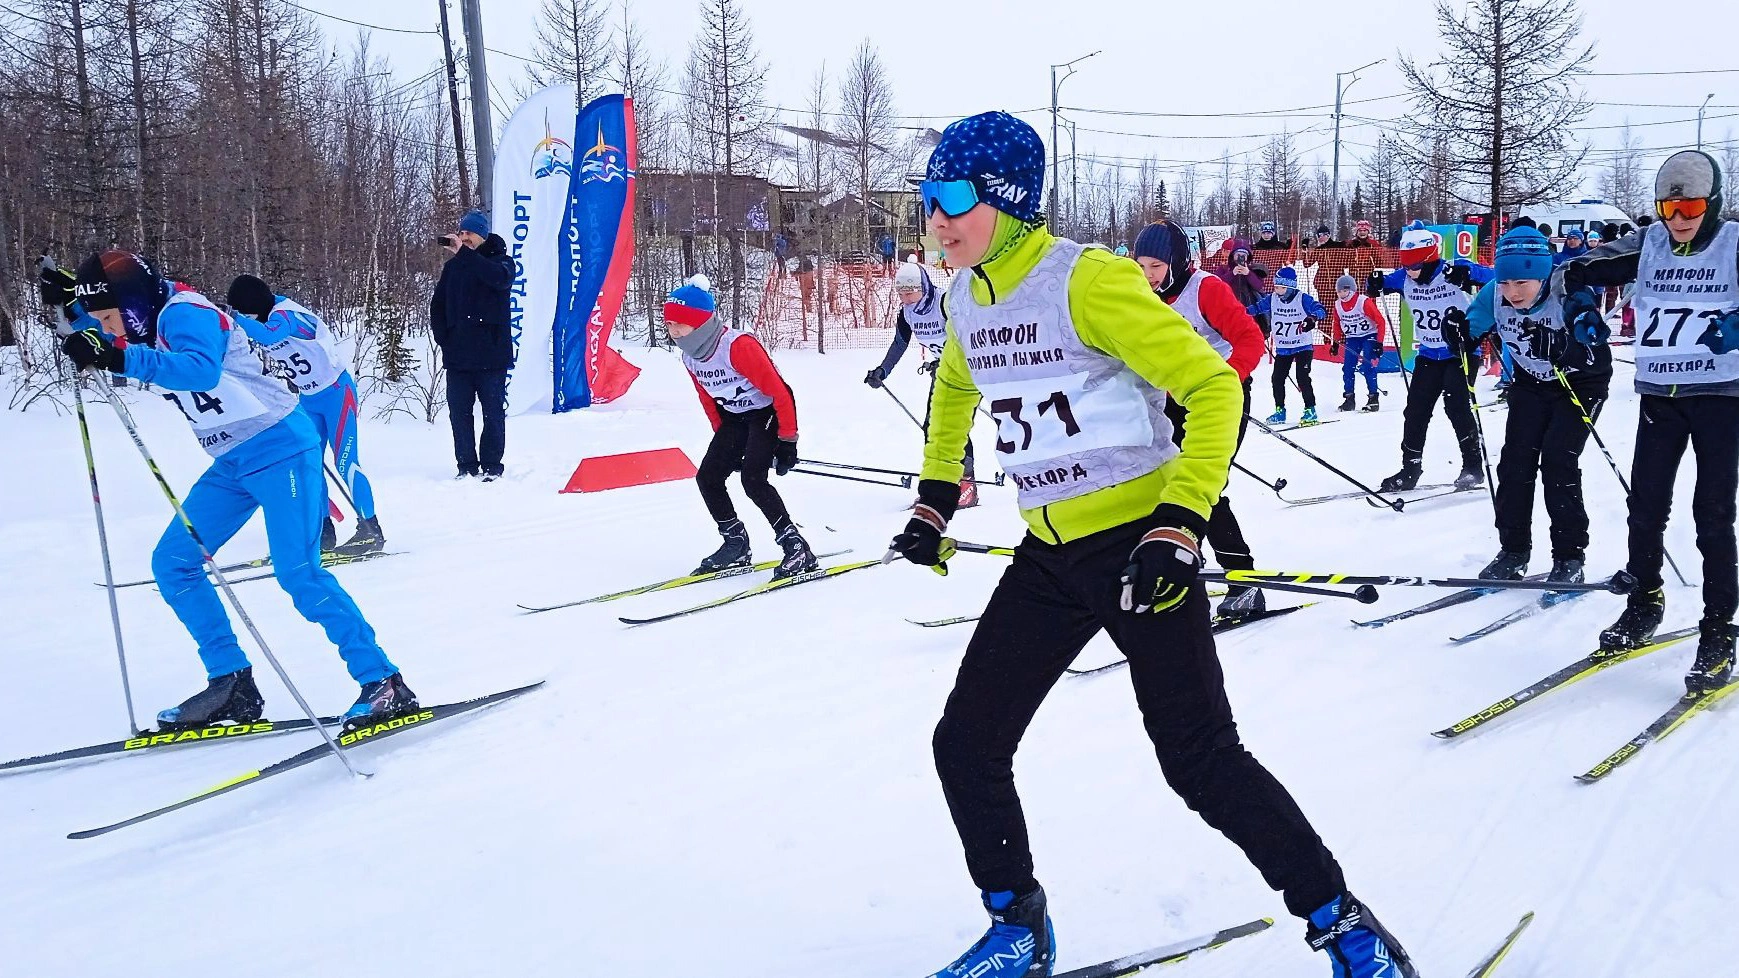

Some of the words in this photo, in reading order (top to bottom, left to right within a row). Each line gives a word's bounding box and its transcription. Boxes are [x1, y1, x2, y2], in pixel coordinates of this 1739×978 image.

[1654, 268, 1716, 281] МААФОН
[1687, 284, 1728, 293] ЛЫЖНЯ
[970, 323, 1038, 350] МАРАФОН
[1275, 321, 1303, 337] 277
[1344, 320, 1370, 334] 278
[1012, 348, 1064, 366] ЛЫЖНЯ
[339, 711, 434, 746] BRADOS
[1453, 697, 1516, 733] FISCHER
[124, 722, 274, 750] BRADOS
[1589, 743, 1637, 777] FISCHER
[961, 933, 1036, 978] PINE
